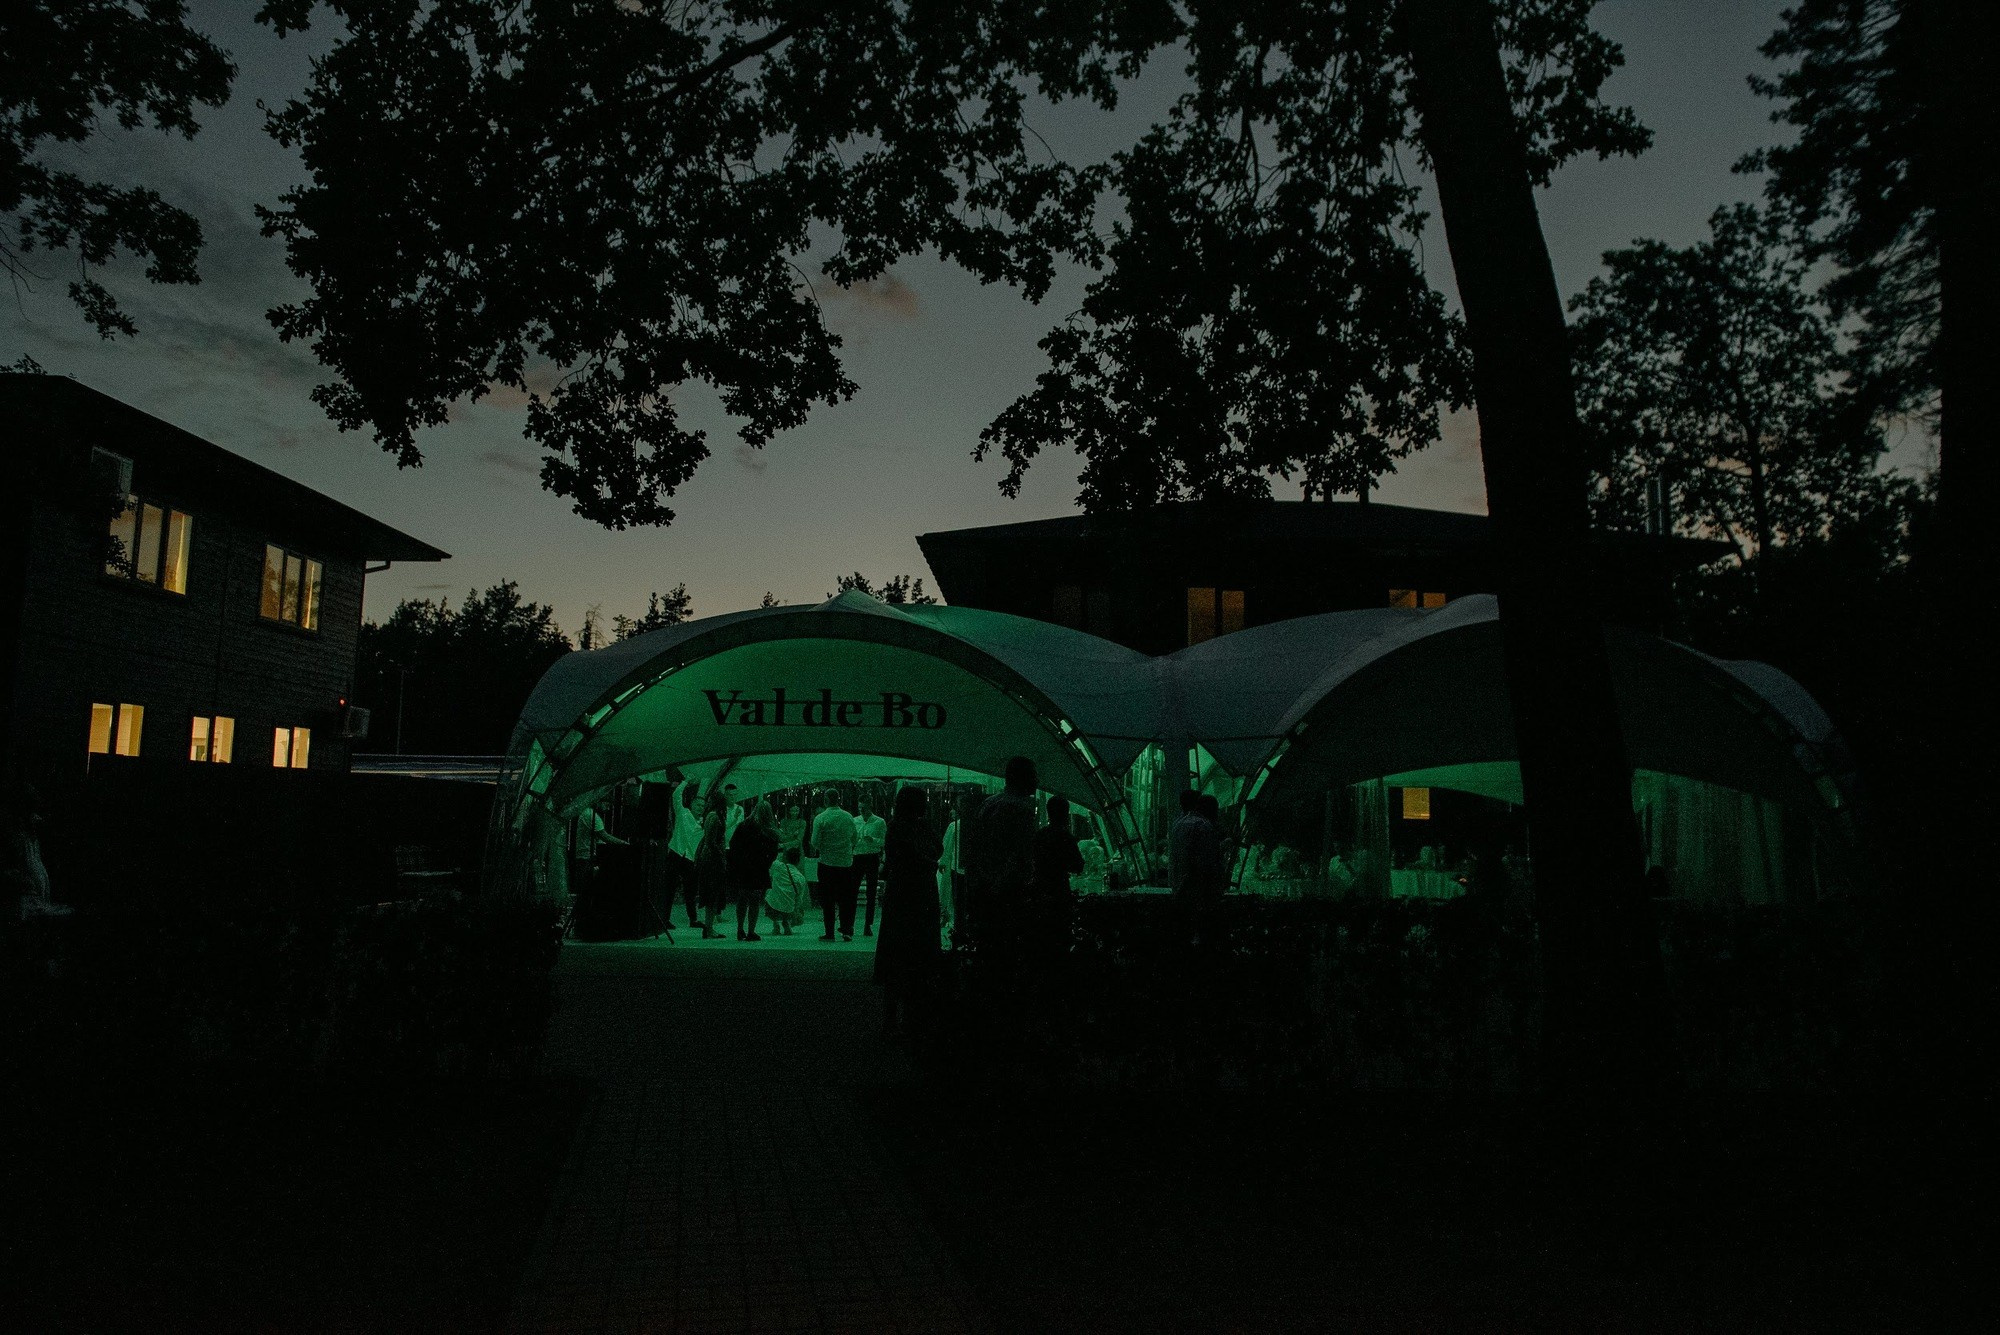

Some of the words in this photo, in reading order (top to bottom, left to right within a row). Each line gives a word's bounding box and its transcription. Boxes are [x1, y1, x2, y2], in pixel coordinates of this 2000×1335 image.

[701, 688, 785, 726] Val
[802, 688, 862, 727] de
[879, 692, 947, 729] Bo
